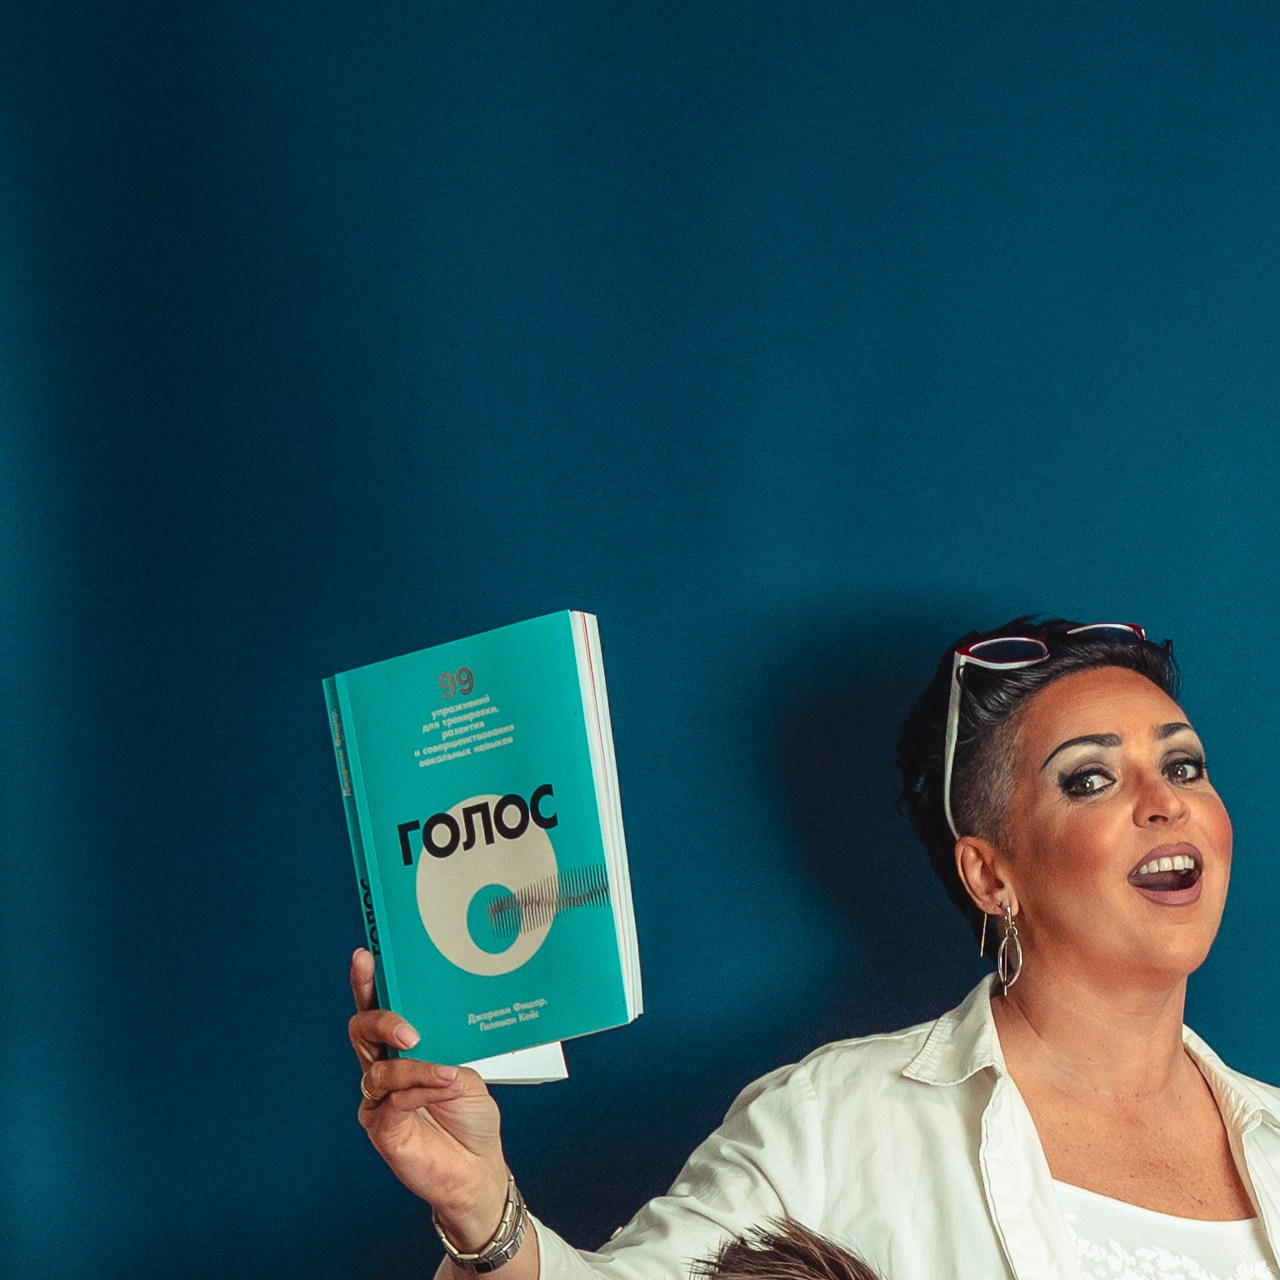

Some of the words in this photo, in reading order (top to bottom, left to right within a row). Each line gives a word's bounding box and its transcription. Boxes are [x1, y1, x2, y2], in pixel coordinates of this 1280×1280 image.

[438, 666, 474, 699] 99
[431, 694, 490, 720] упражнений
[422, 721, 440, 734] для
[441, 721, 485, 741] развития
[419, 748, 472, 767] вокальных
[473, 736, 514, 753] навыков
[397, 784, 559, 866] ГОЛОС
